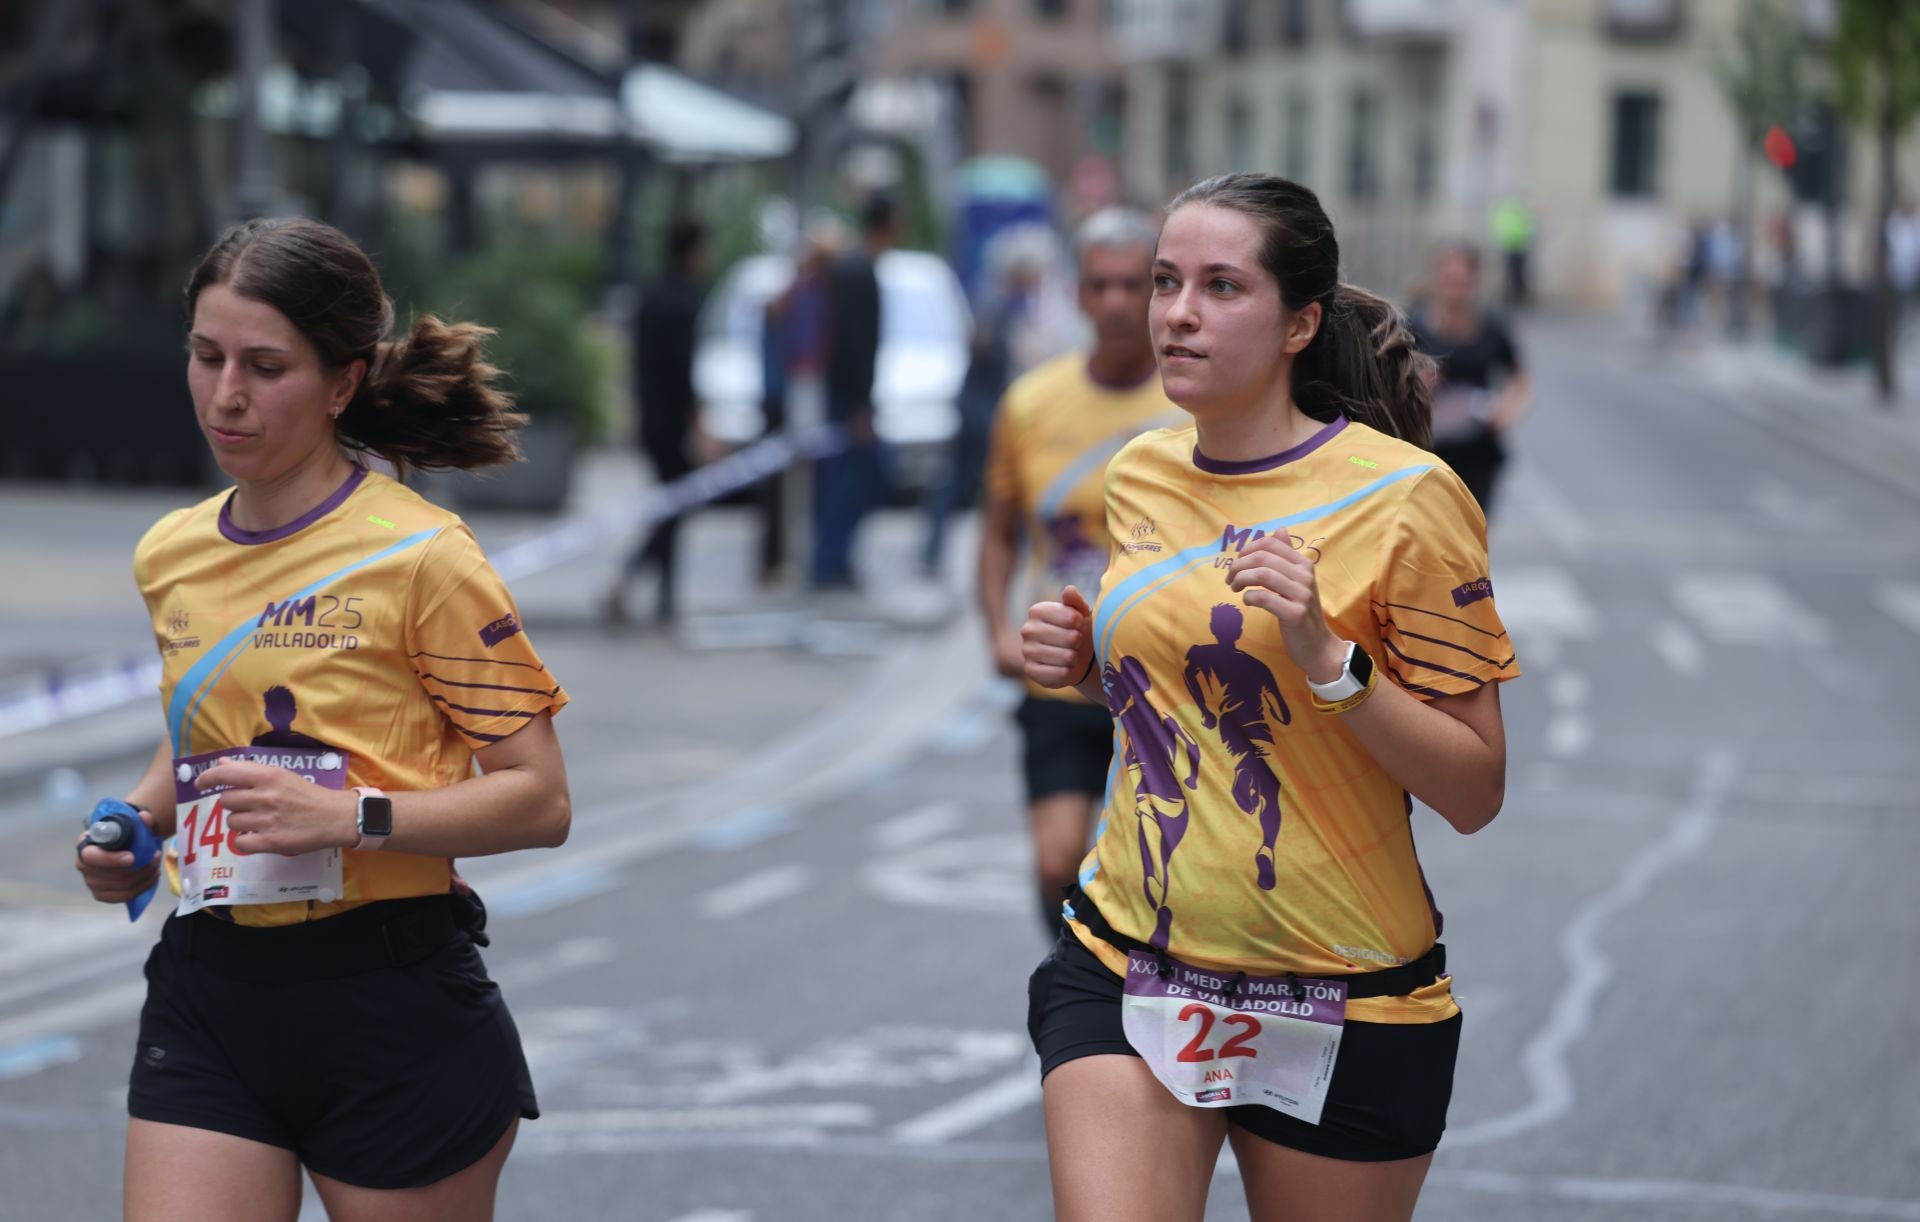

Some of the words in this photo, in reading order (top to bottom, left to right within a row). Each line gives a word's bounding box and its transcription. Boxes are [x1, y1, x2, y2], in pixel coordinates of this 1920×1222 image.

[257, 595, 364, 629] MM25
[254, 631, 359, 650] VALLADOLID
[253, 752, 342, 769] MARAT
[211, 867, 234, 879] FELI
[1131, 957, 1179, 979] XXXI
[1248, 982, 1342, 1002] MARTÓN
[1167, 983, 1191, 996] DE
[1197, 990, 1314, 1017] VALLADOLID
[1177, 1003, 1263, 1063] 22
[1204, 1068, 1233, 1083] ANA
